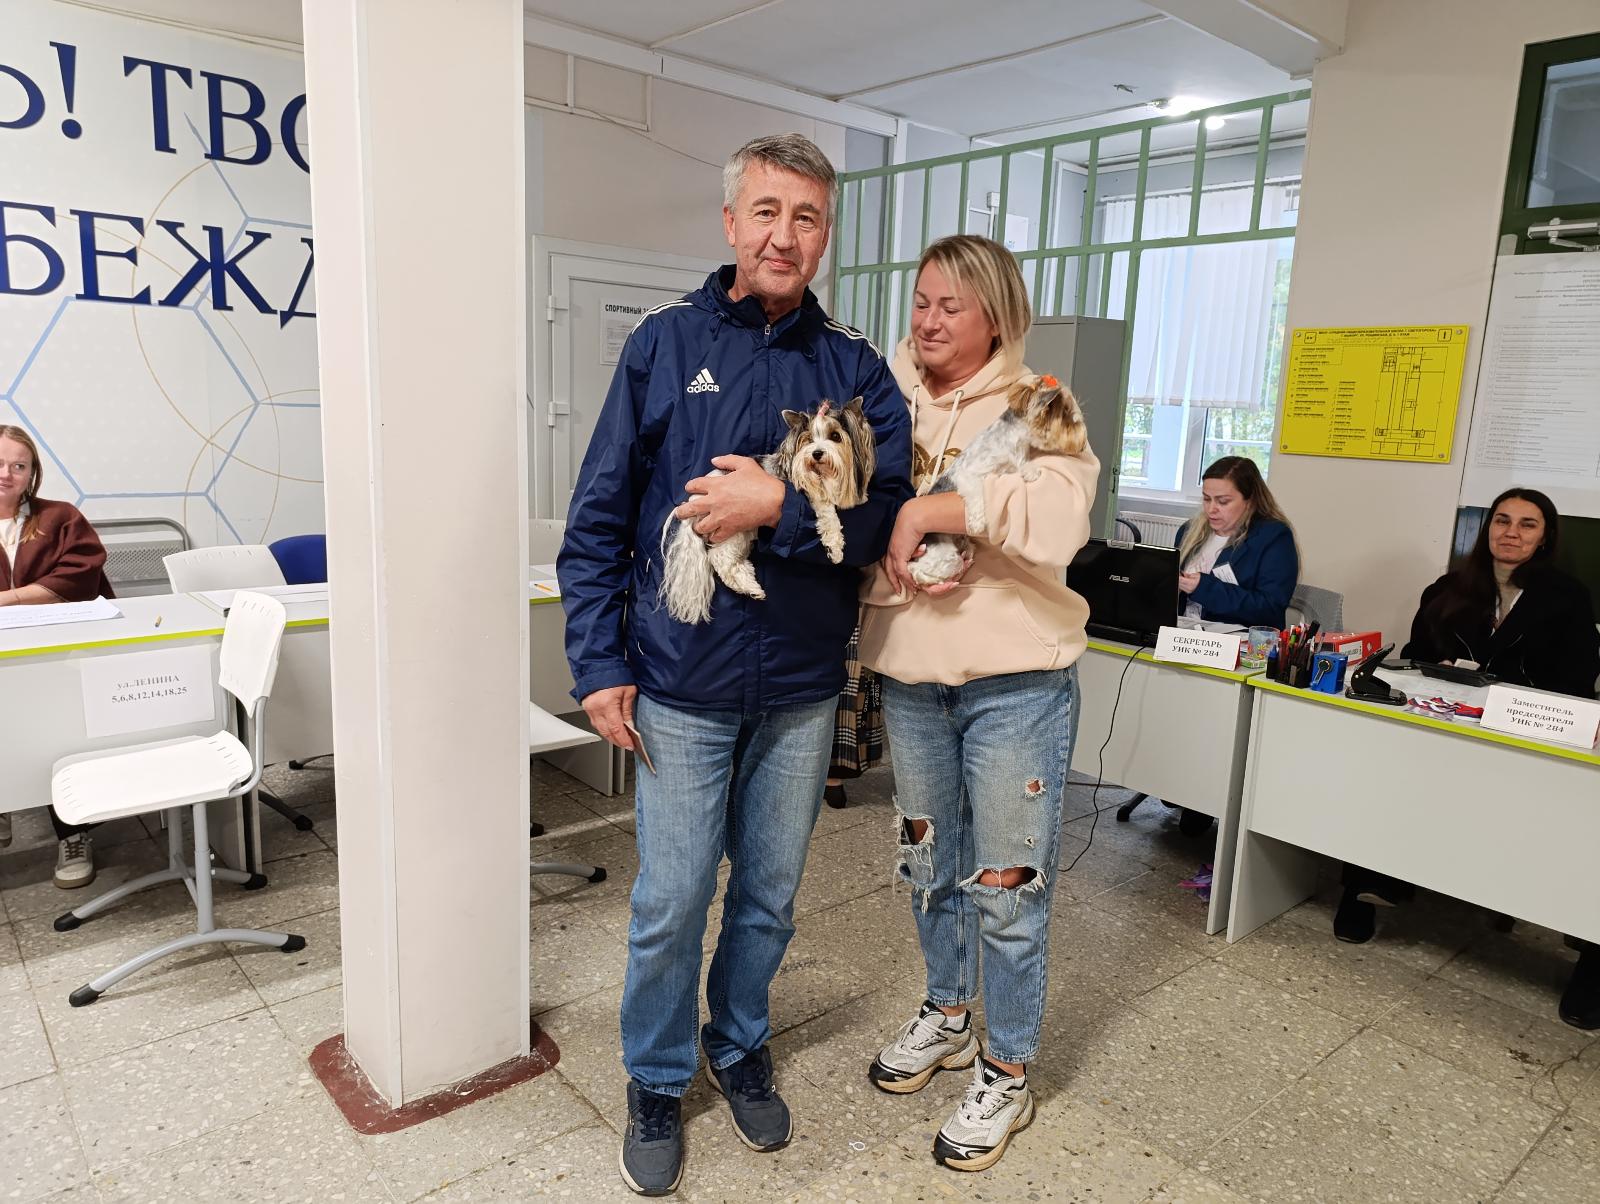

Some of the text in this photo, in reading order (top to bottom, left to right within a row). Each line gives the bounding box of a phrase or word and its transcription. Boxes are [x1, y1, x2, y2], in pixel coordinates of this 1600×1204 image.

[605, 303, 642, 315] СПОРТИВНЫЙ
[1109, 574, 1130, 583] ASUS
[1173, 636, 1222, 649] СЕКРЕТАРЬ
[1172, 645, 1190, 654] УИК
[1203, 649, 1219, 657] 284
[1511, 697, 1574, 716] Заместитель
[1506, 707, 1575, 726] председателя
[1510, 716, 1564, 733] УИК № 284
